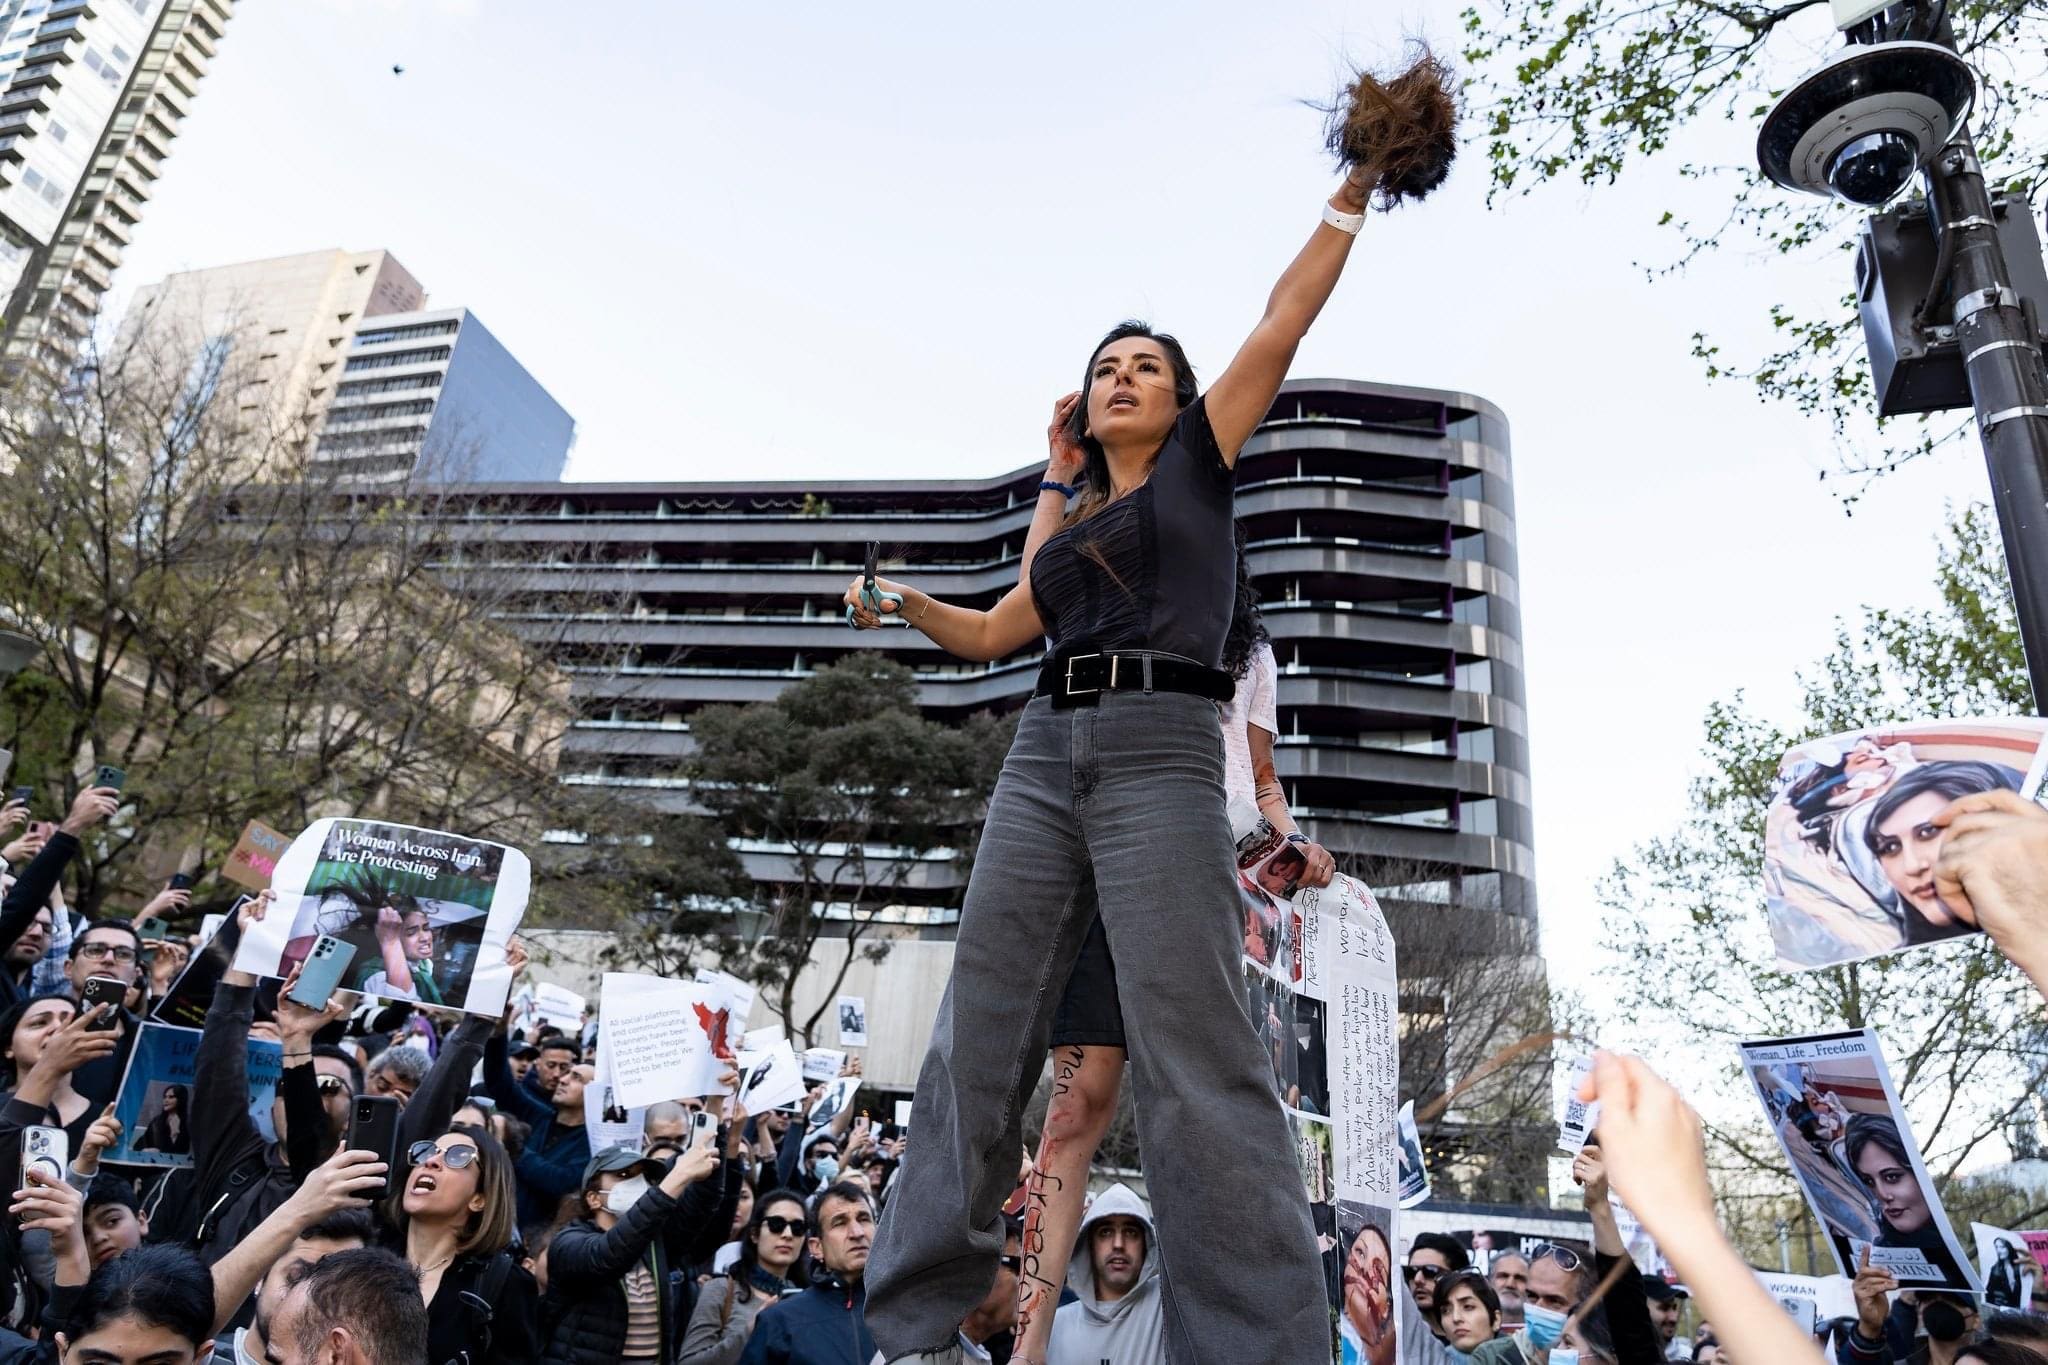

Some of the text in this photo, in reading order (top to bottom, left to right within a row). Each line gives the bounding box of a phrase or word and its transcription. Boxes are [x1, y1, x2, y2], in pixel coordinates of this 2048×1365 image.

[337, 829, 482, 867] Women Across Iran
[328, 847, 439, 881] Are Protesting
[1354, 927, 1369, 958] life
[1306, 952, 1319, 986] Neda
[1341, 985, 1350, 1017] beaten
[1350, 985, 1359, 1004] law
[621, 1015, 642, 1026] social
[645, 1008, 681, 1023] platforms
[1351, 1007, 1361, 1035] hijab
[612, 1028, 627, 1037] and
[1342, 1021, 1350, 1049] being
[1815, 1041, 1866, 1057] Freedom
[1341, 1089, 1350, 1114] dies
[1353, 1114, 1365, 1163] morality
[1354, 1173, 1363, 1188] by
[1886, 1264, 1937, 1277] AMINI
[1769, 1282, 1817, 1296] WOMAN
